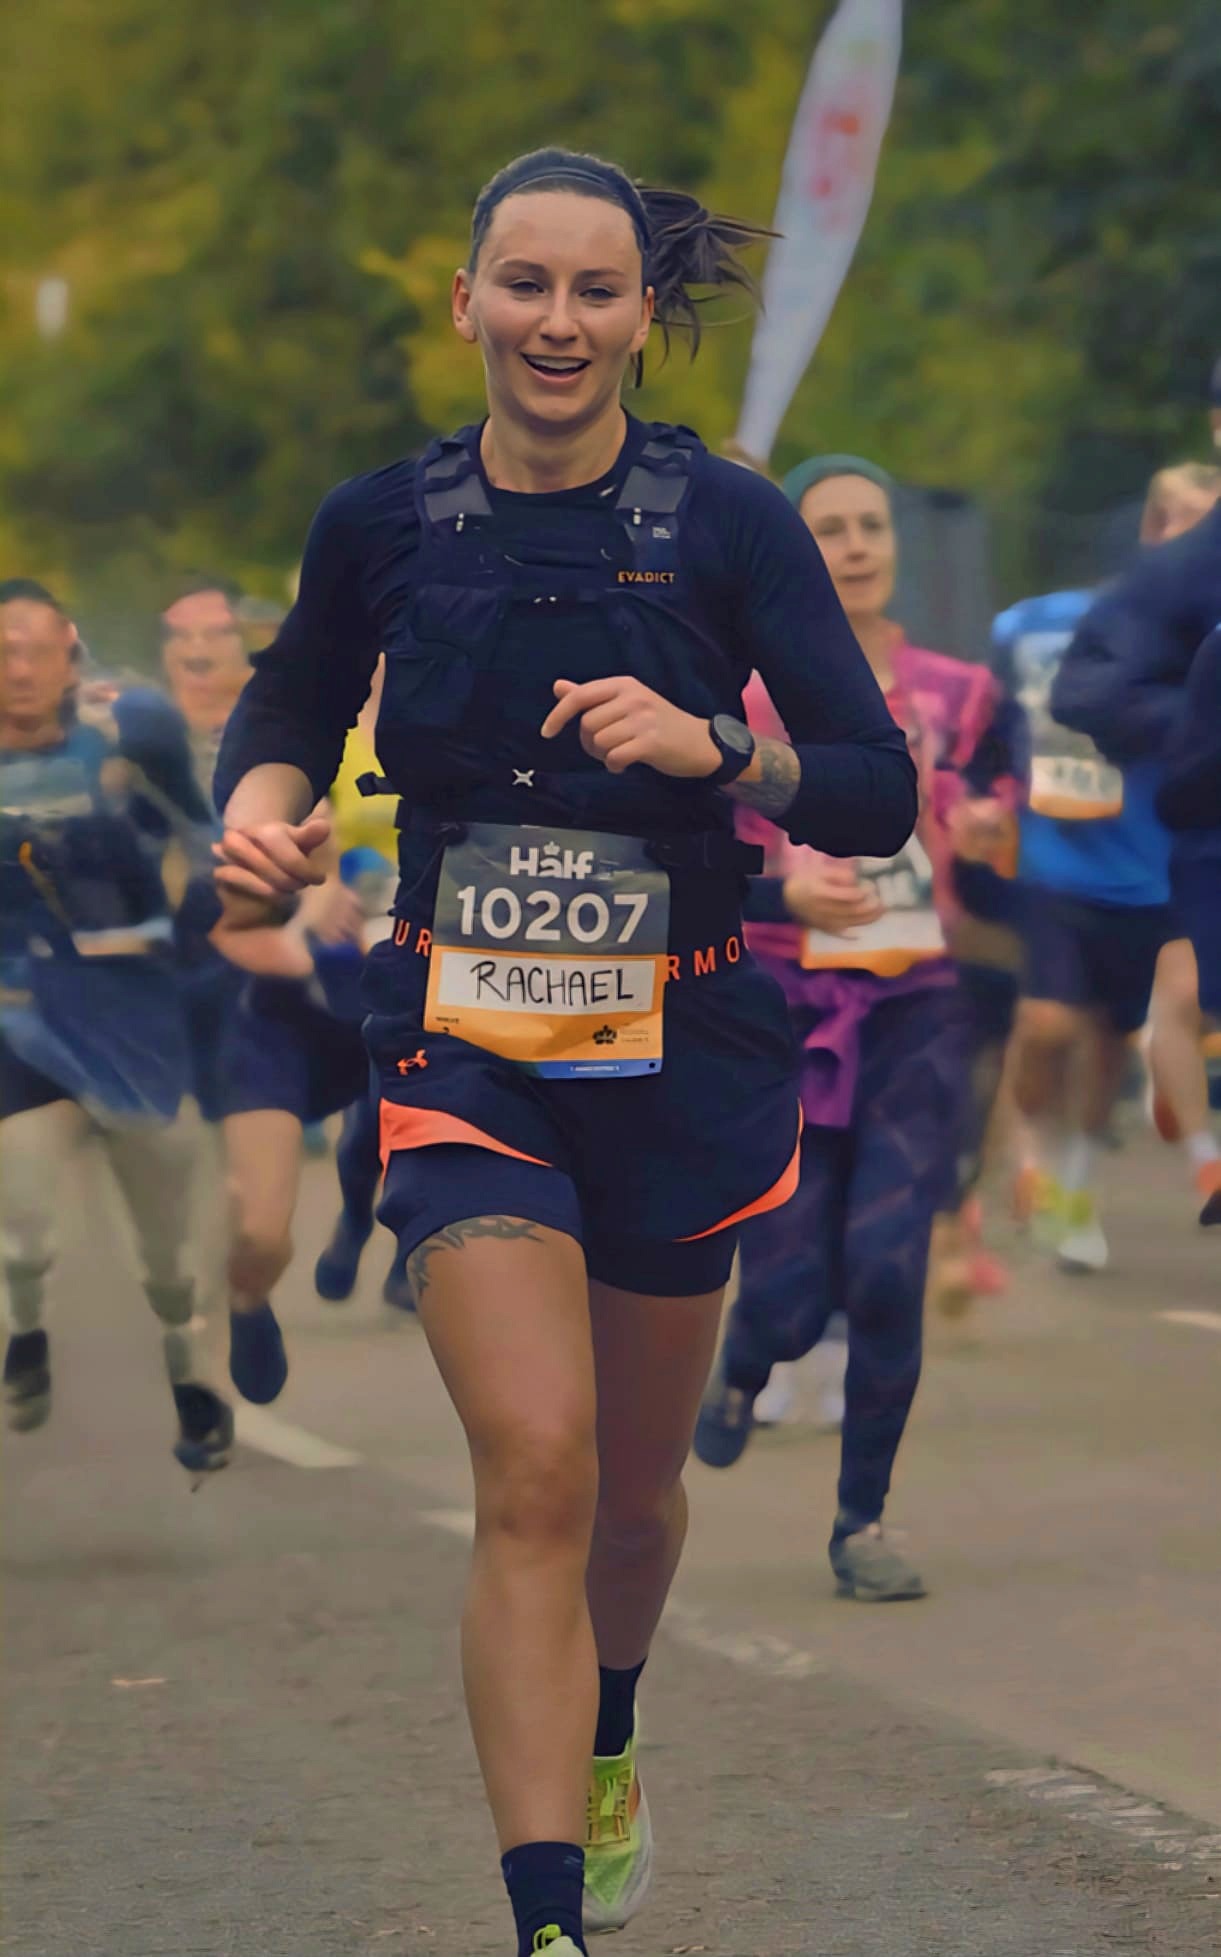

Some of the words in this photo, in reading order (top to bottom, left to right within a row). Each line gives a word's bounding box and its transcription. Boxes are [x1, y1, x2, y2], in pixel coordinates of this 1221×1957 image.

[618, 571, 675, 583] EVADICT
[510, 845, 595, 880] Half
[457, 885, 649, 944] 10207
[470, 960, 635, 1007] RACHAEL
